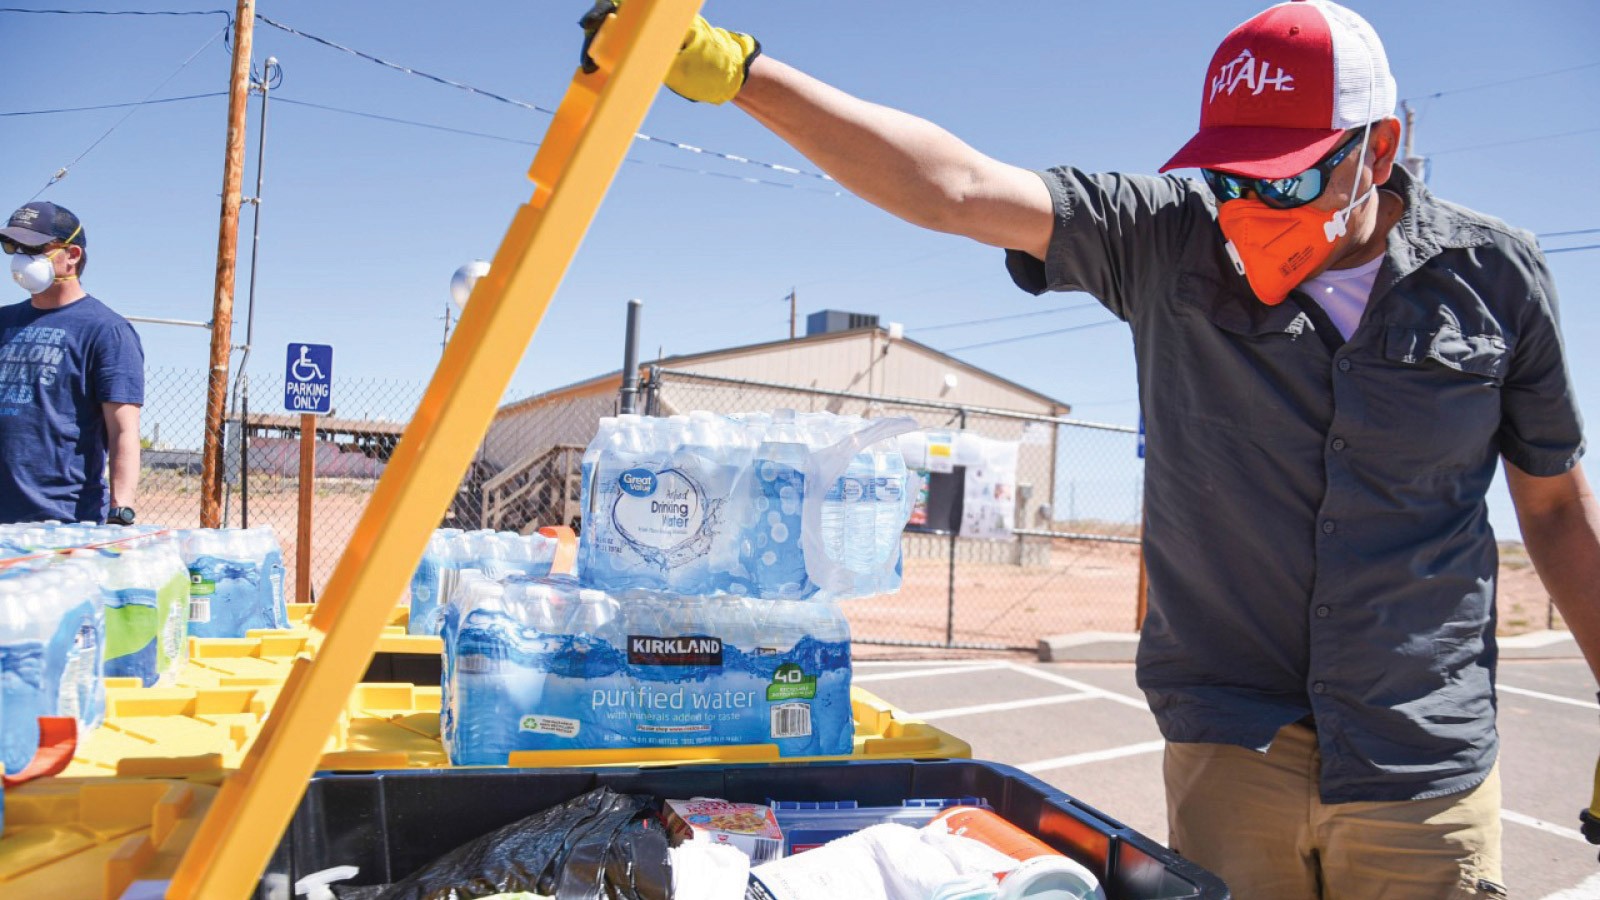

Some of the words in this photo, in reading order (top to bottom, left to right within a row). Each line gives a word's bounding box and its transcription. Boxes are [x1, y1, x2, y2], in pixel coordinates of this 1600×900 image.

[287, 382, 329, 397] PARKING
[293, 395, 320, 410] ONLY
[623, 473, 652, 485] Great
[651, 501, 689, 518] Drinking
[633, 638, 720, 654] KIRKLAND
[774, 669, 802, 683] 40
[591, 686, 684, 710] purified
[693, 689, 756, 710] water
[607, 711, 627, 720] with
[629, 711, 670, 722] minerals
[672, 711, 702, 722] added
[704, 711, 716, 721] for
[718, 711, 741, 721] taste
